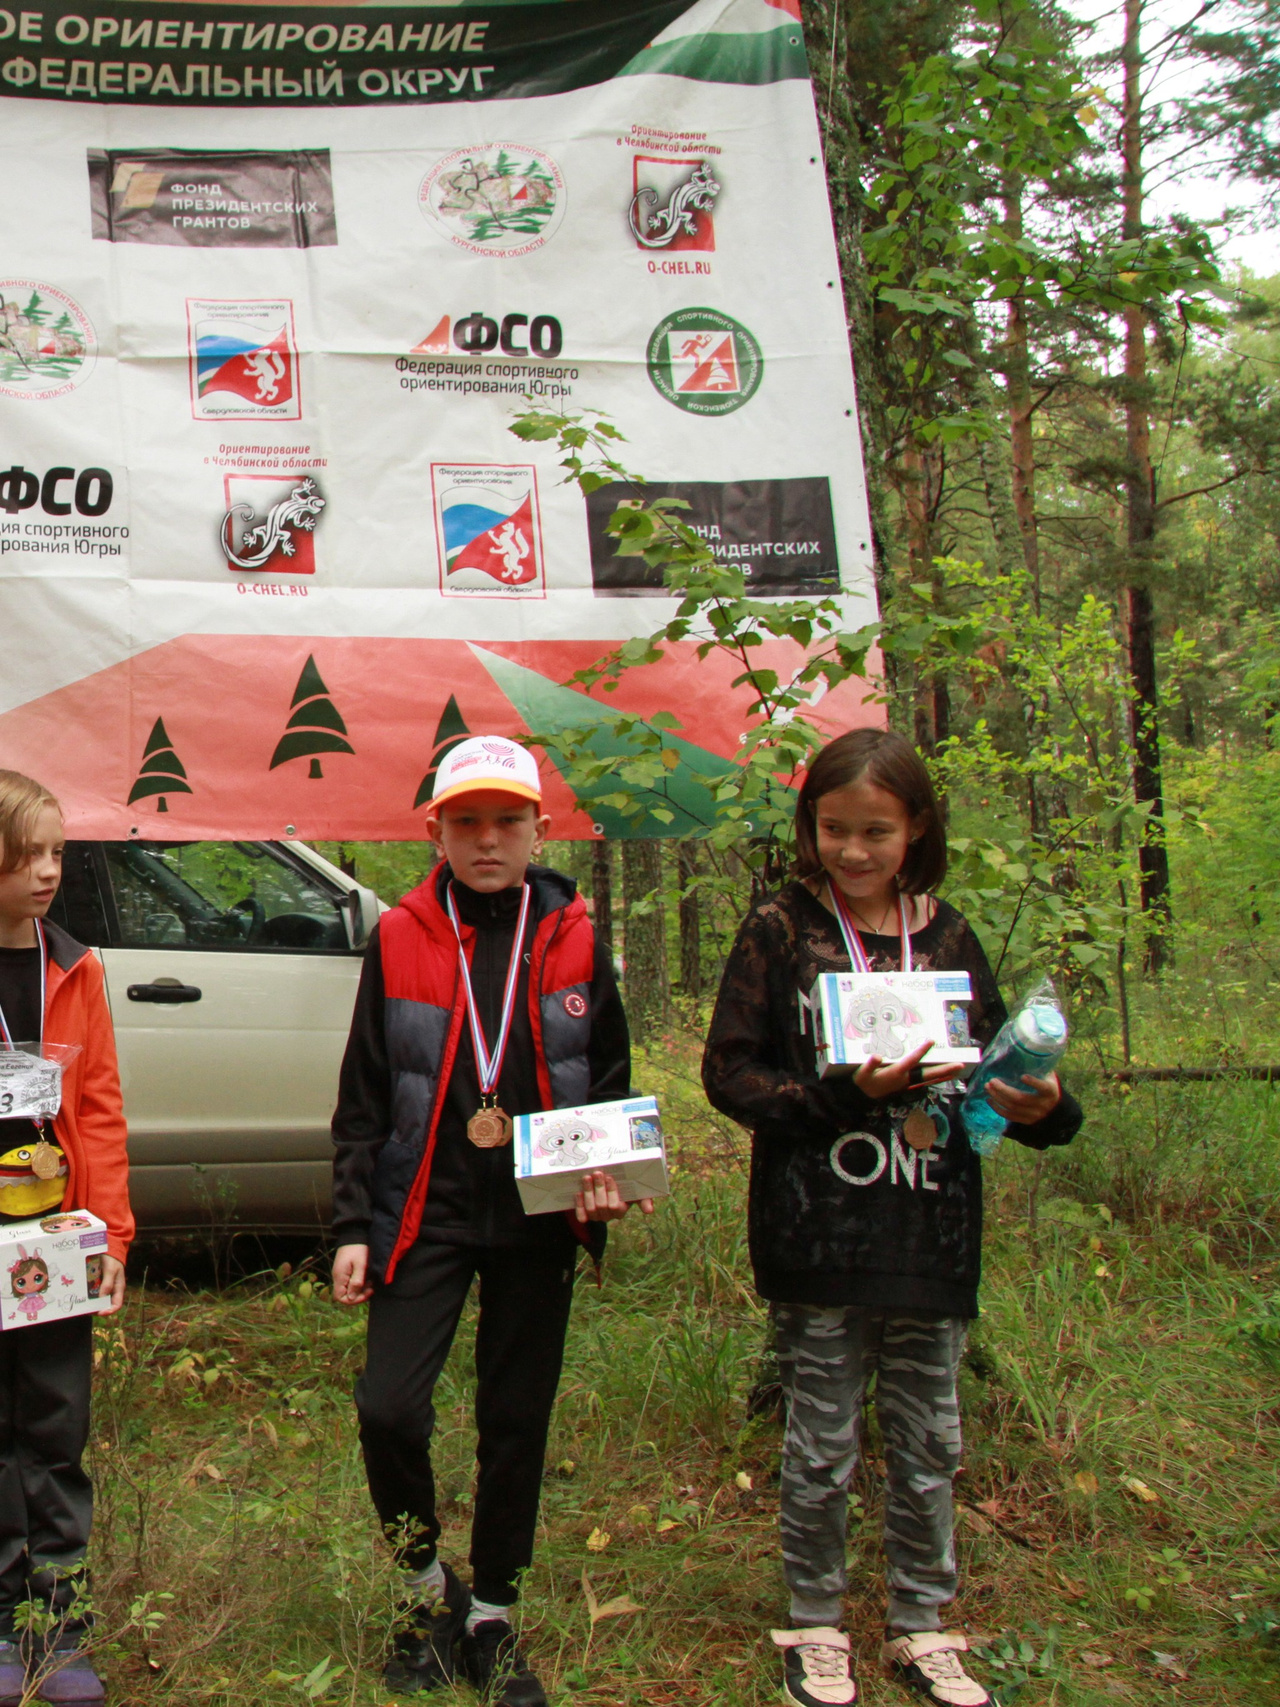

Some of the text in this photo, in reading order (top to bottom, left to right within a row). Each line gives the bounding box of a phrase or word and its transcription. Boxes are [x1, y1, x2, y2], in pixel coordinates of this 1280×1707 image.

[55, 15, 490, 53] ОРИЕНТИРОВАНИЕ
[2, 56, 345, 97] ФЕДЕРАЛЬНЫЙ
[358, 66, 495, 96] ОКРУГ
[632, 124, 707, 141] Ориентирование
[625, 136, 679, 153] Челябинской
[682, 142, 722, 154] области
[442, 142, 501, 165] СПОРТИВНОГО
[503, 142, 563, 189] ОРИЕНТИРОВАНИЯ
[170, 183, 222, 196] ФОНД
[172, 198, 318, 213] ПРЕЗИДЕНТСКИХ
[173, 216, 251, 229] ГРАНТОВ
[451, 235, 546, 258] КУРГАНСКОЙ ОБЛАСТИ
[648, 260, 711, 275] O-CHEL.RU
[38, 284, 94, 343] ОРИЕНТИРОВАНИЯ
[677, 312, 734, 330] СПОРТИВНОГО
[453, 312, 562, 358] ФСО
[395, 357, 579, 380] Федерация спортивного
[36, 383, 76, 400] ОБЛАСТИ
[400, 377, 571, 396] ориентирования Югры
[687, 398, 739, 412] ТЮМЕНСКОЙ
[219, 444, 310, 456] Ориентирование
[213, 456, 279, 468] Челябинской
[282, 457, 328, 468] области
[25, 523, 129, 539] спортивного
[75, 539, 121, 558] Югры
[673, 541, 821, 559] ЗИДЕНТСКИХ
[237, 582, 308, 596] O-CHEL.RU
[902, 978, 933, 989] набор
[829, 1128, 940, 1191] ONE
[52, 1239, 79, 1249] набор
